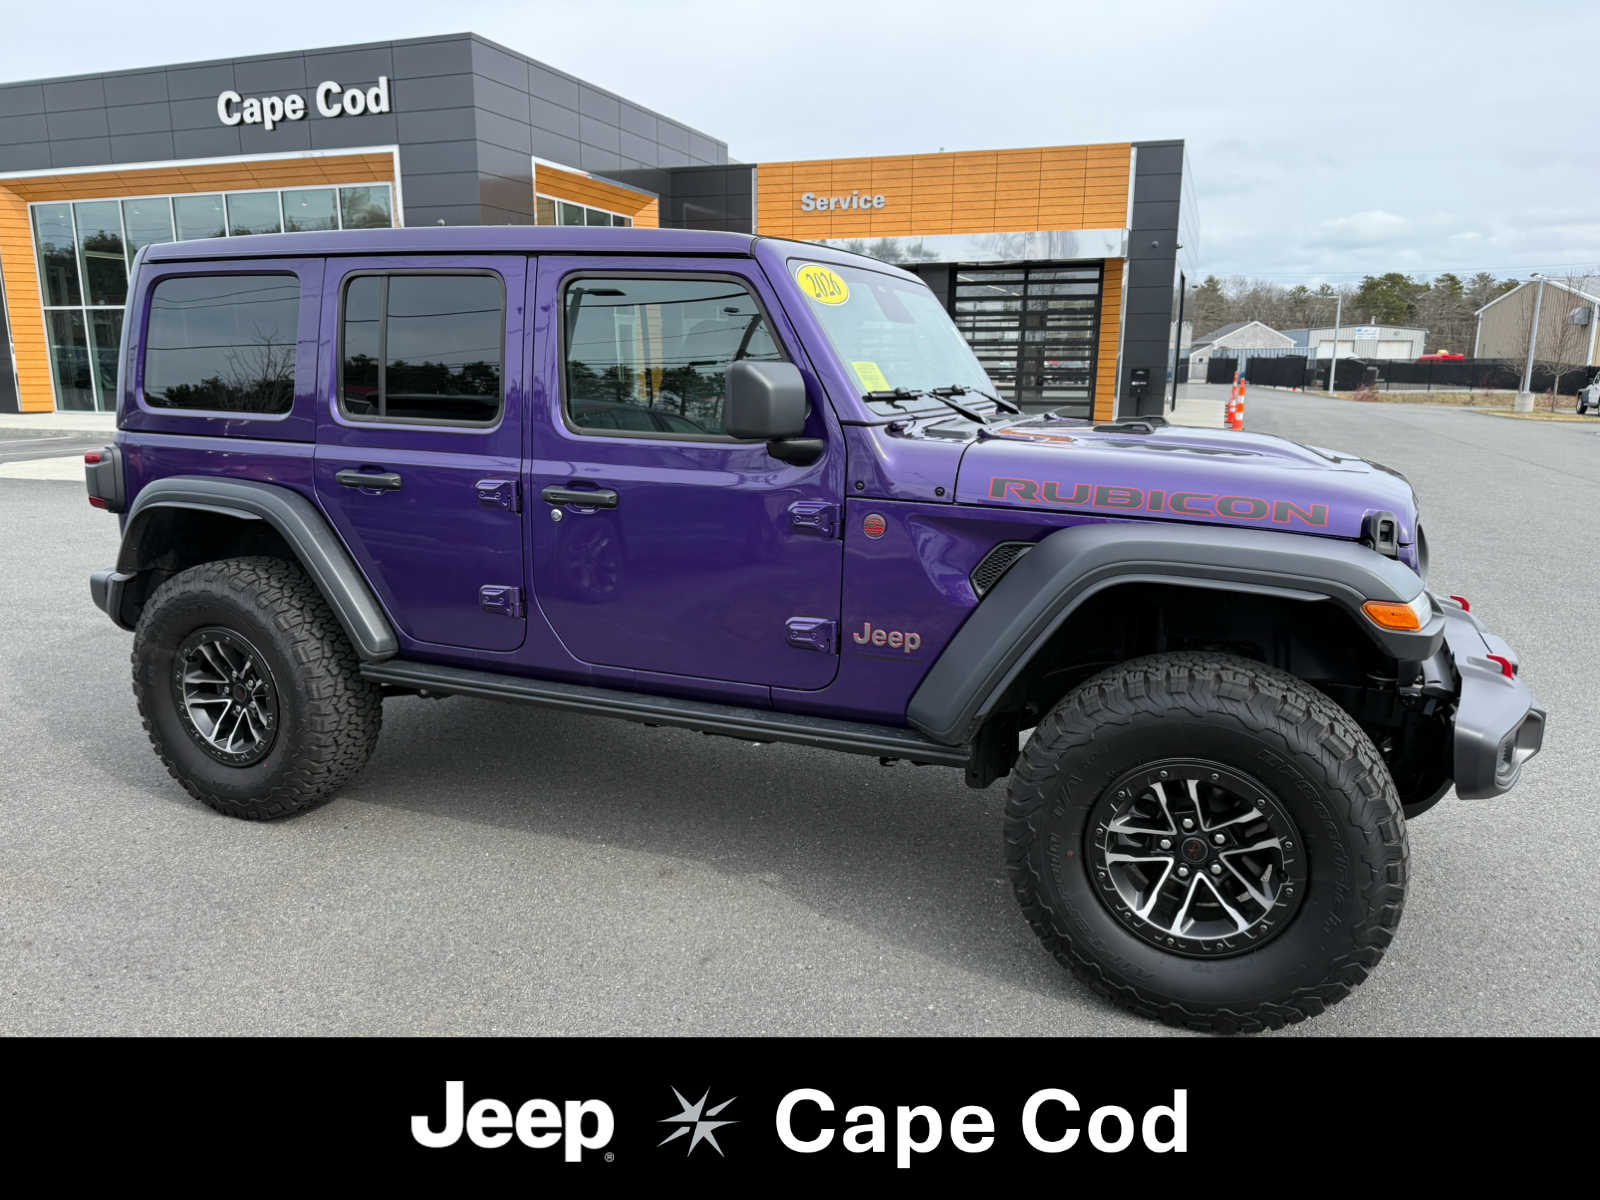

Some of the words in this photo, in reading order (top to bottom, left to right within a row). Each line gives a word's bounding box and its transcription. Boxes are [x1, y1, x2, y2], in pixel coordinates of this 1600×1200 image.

[217, 90, 305, 130] Cape
[316, 76, 390, 118] Cod
[801, 190, 886, 212] Service
[806, 272, 841, 298] 2026
[988, 476, 1330, 529] RUBICON
[853, 622, 921, 654] Jeep
